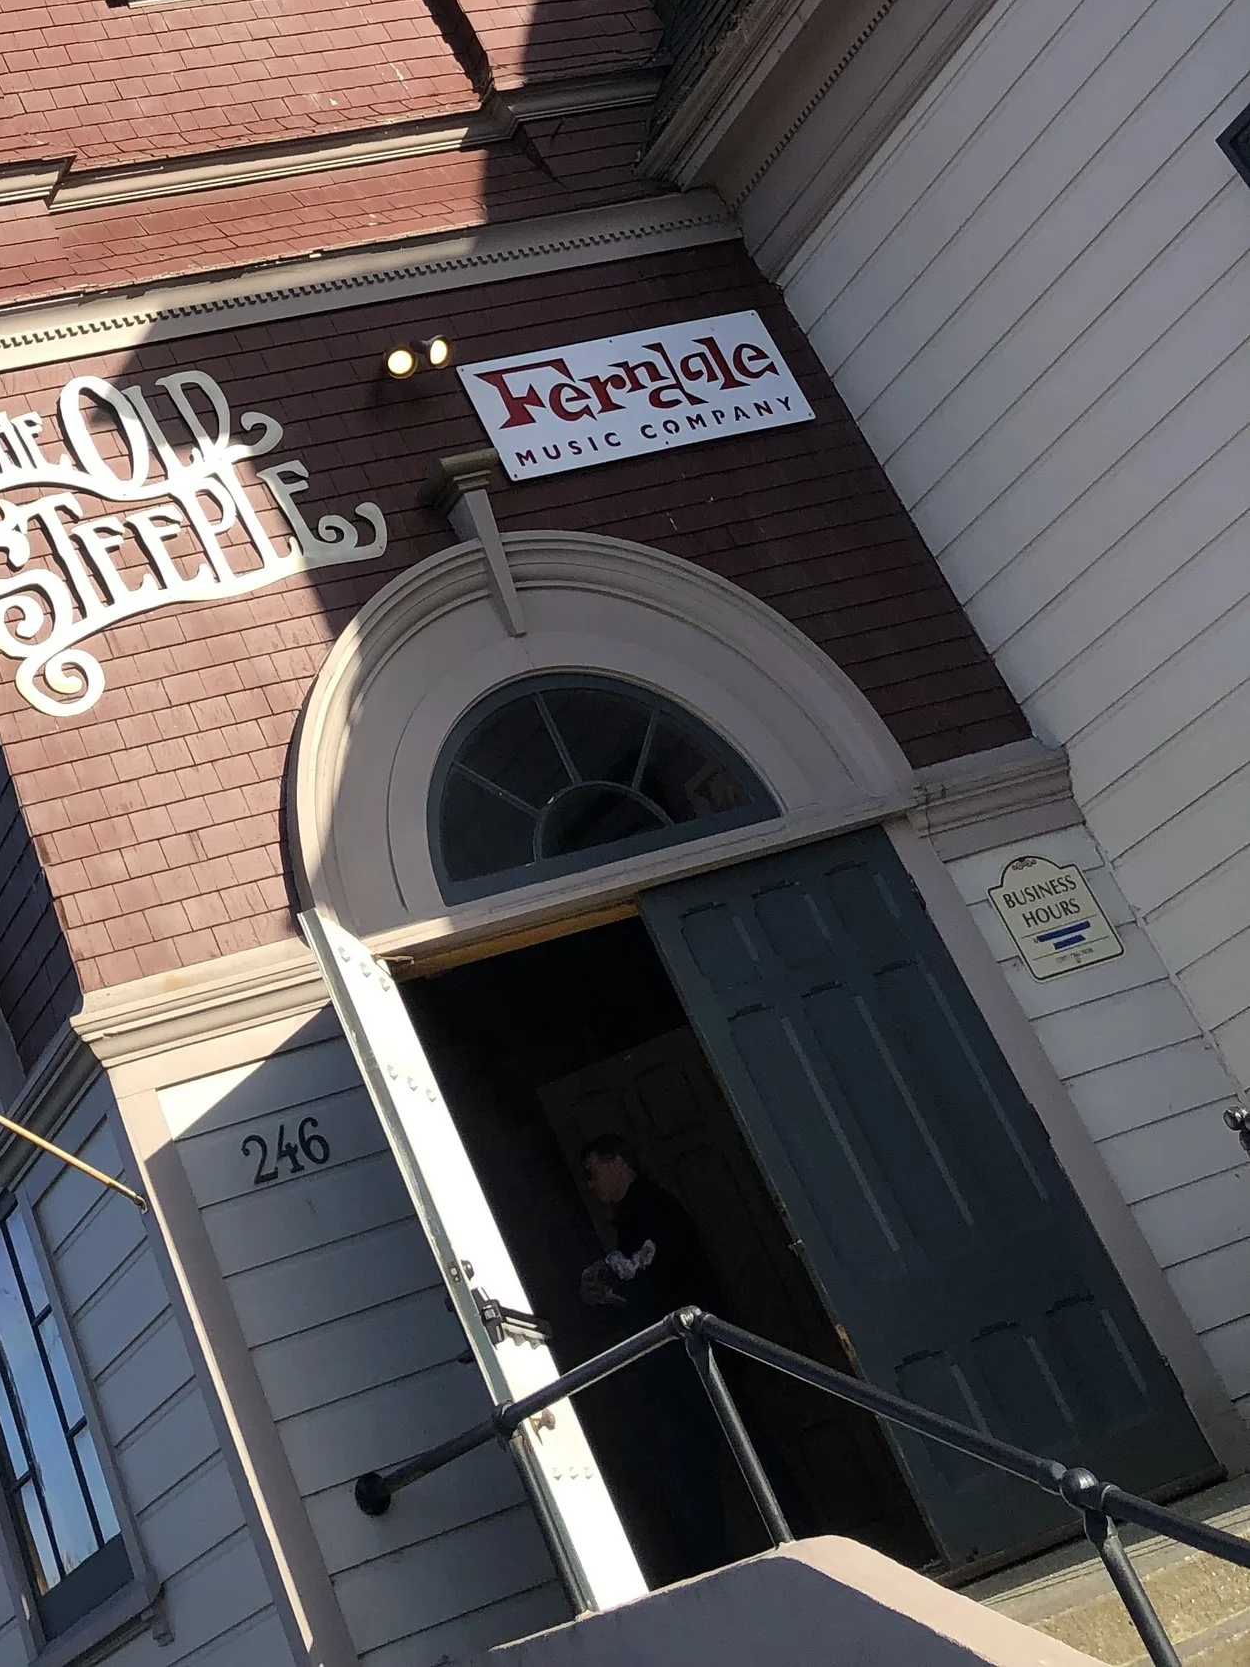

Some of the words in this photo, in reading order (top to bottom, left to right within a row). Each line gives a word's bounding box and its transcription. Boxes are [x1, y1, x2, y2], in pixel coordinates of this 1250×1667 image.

[473, 336, 779, 430] Ferndale
[515, 432, 622, 467] MUSIC
[640, 395, 793, 440] COMPANY
[1002, 874, 1077, 909] BUSINESS
[1022, 897, 1081, 928] HOURS
[241, 1116, 330, 1185] 246
